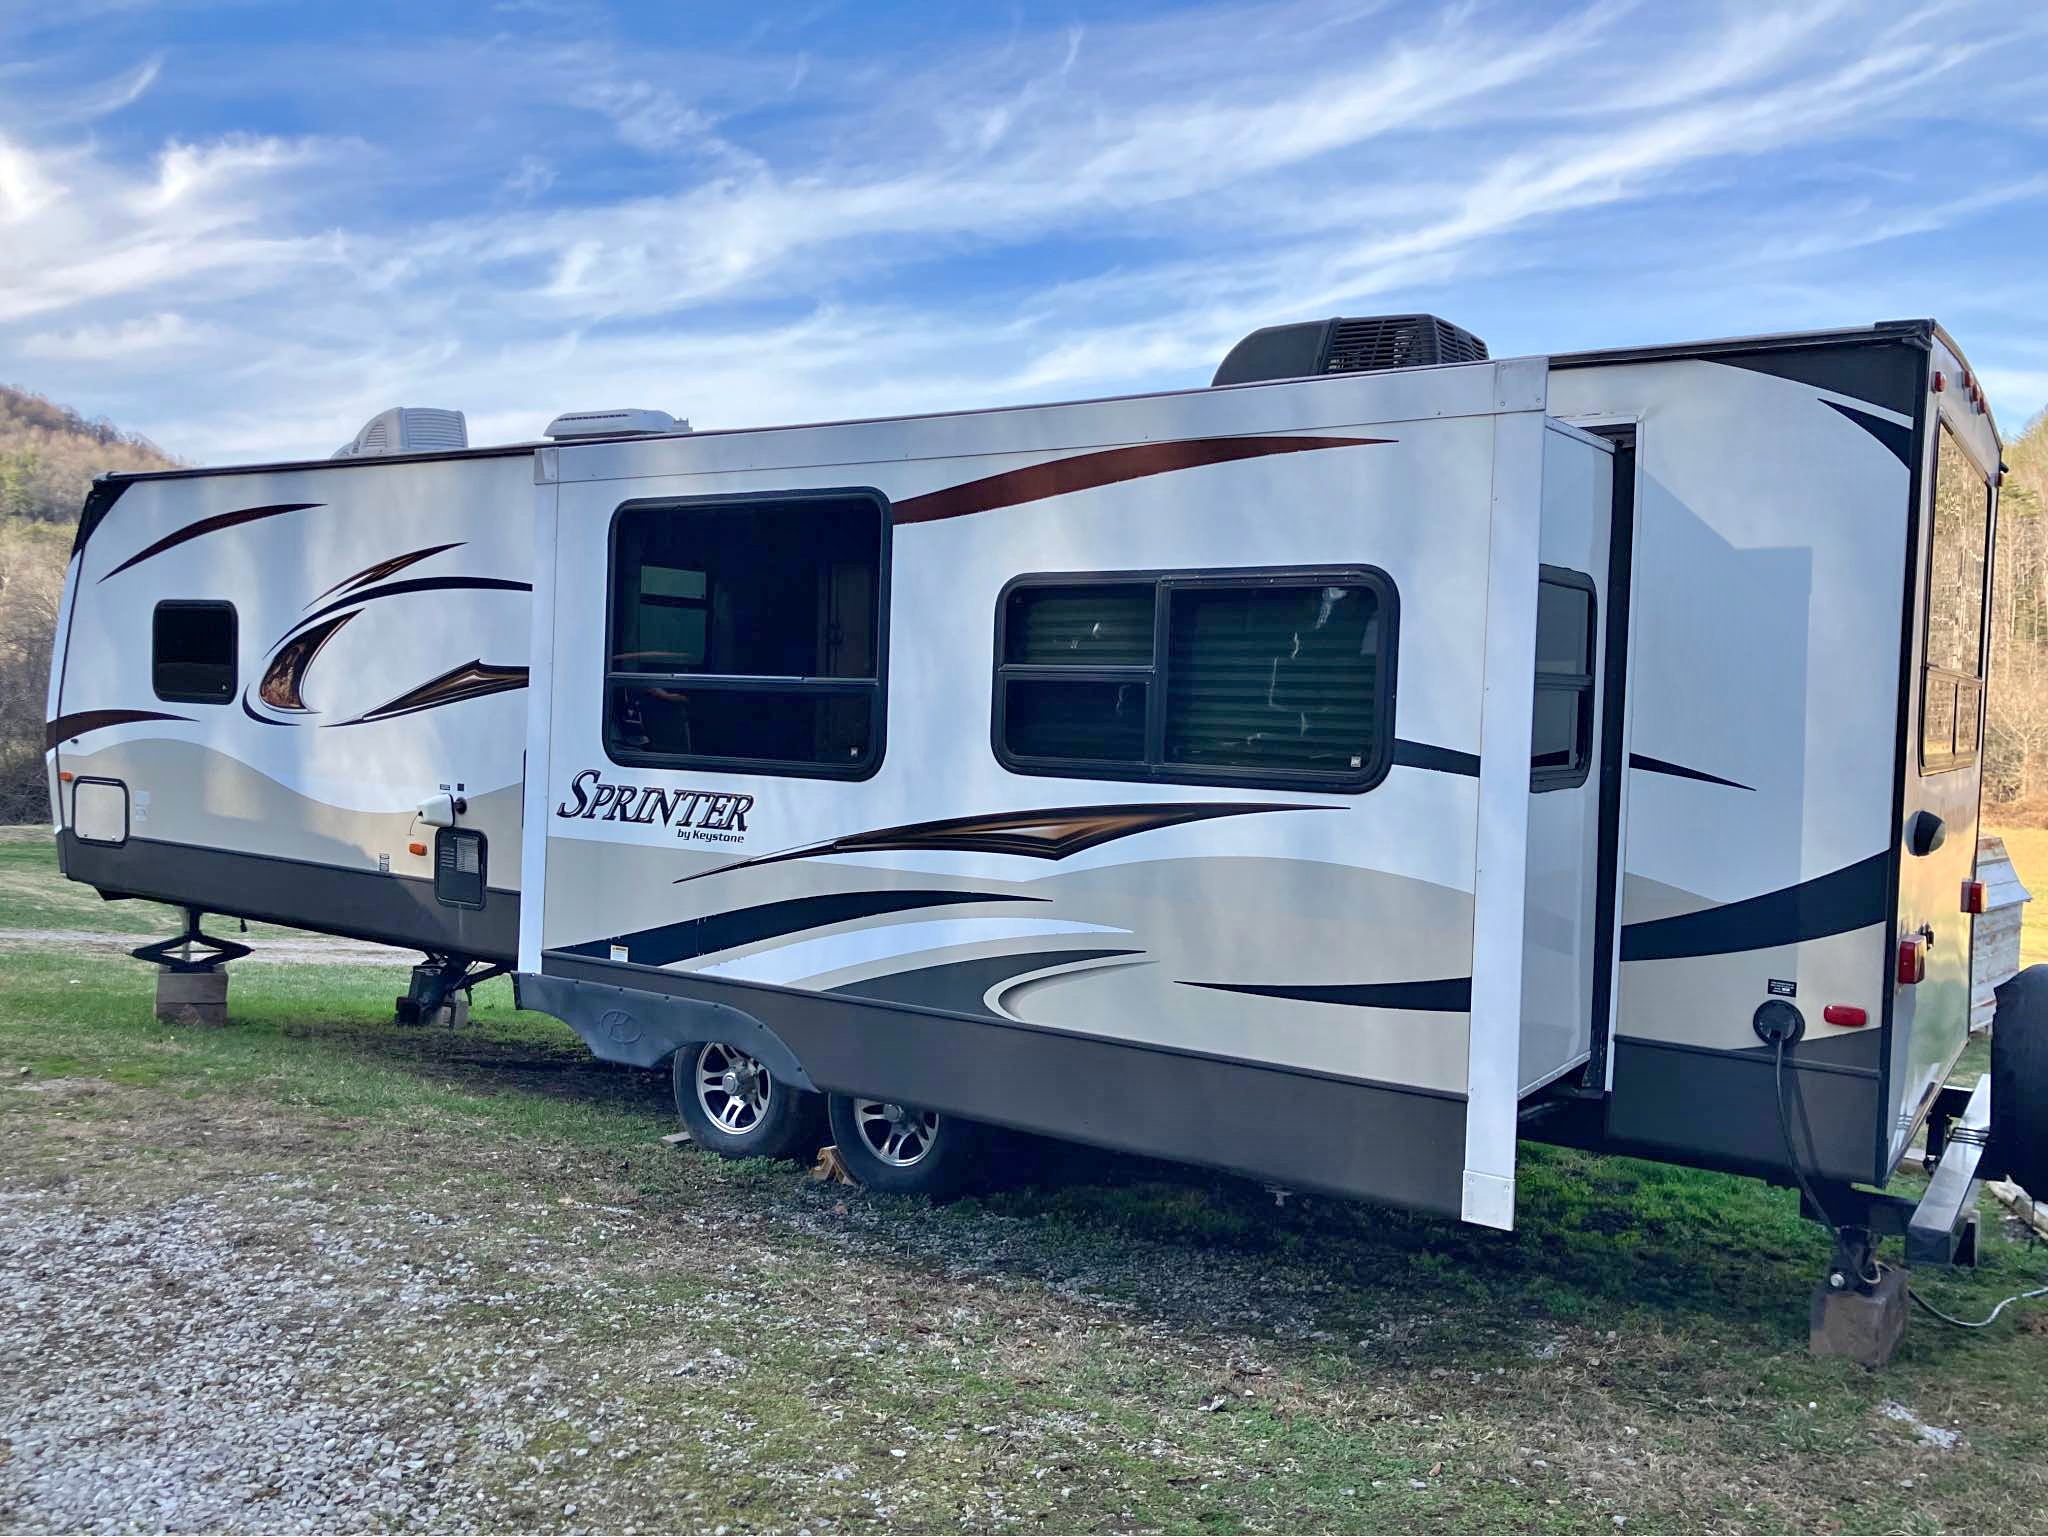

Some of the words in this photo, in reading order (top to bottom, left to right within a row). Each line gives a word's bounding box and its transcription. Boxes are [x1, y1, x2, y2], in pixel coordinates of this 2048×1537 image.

[557, 769, 755, 831] SPRINTER
[677, 829, 691, 841] by
[693, 829, 745, 843] Keystone
